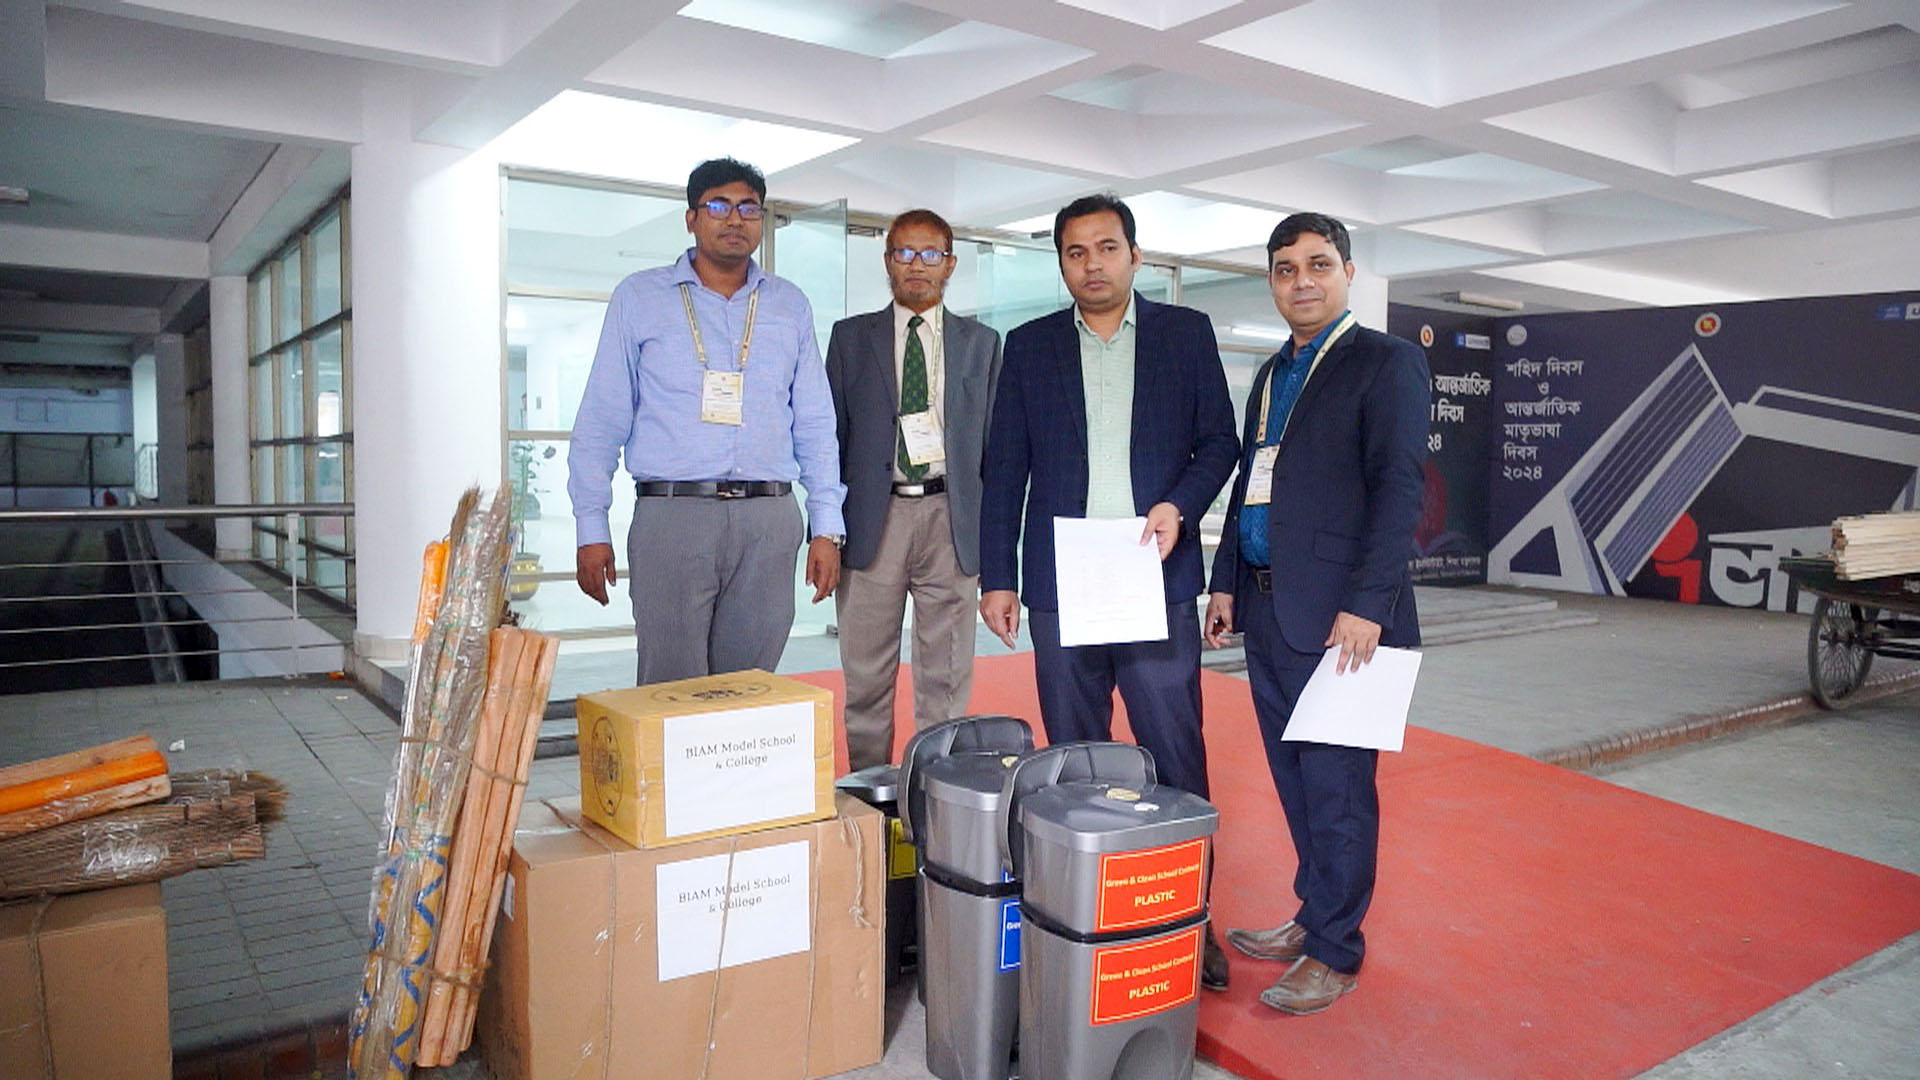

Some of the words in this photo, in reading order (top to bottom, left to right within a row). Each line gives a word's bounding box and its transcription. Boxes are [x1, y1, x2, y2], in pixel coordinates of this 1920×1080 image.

[1505, 358, 1543, 378] শহিদ
[1546, 356, 1584, 376] দিবস
[1537, 382, 1550, 396] ও
[1437, 398, 1465, 423] দিবস
[1504, 396, 1582, 417] আন্তর্জাতিক
[1504, 422, 1562, 442] মাতৃভাষা
[1427, 433, 1442, 453] ২৪
[1503, 442, 1538, 461] দিবস
[1503, 465, 1543, 481] ২০২৪
[685, 744, 718, 760] BIAM
[721, 738, 757, 754] Model
[759, 733, 797, 749] School
[725, 754, 768, 768] College
[678, 888, 711, 904] BIAM
[753, 874, 792, 890] School
[1134, 890, 1176, 907] PLASTIC
[1128, 980, 1171, 1000] PLASTIC
